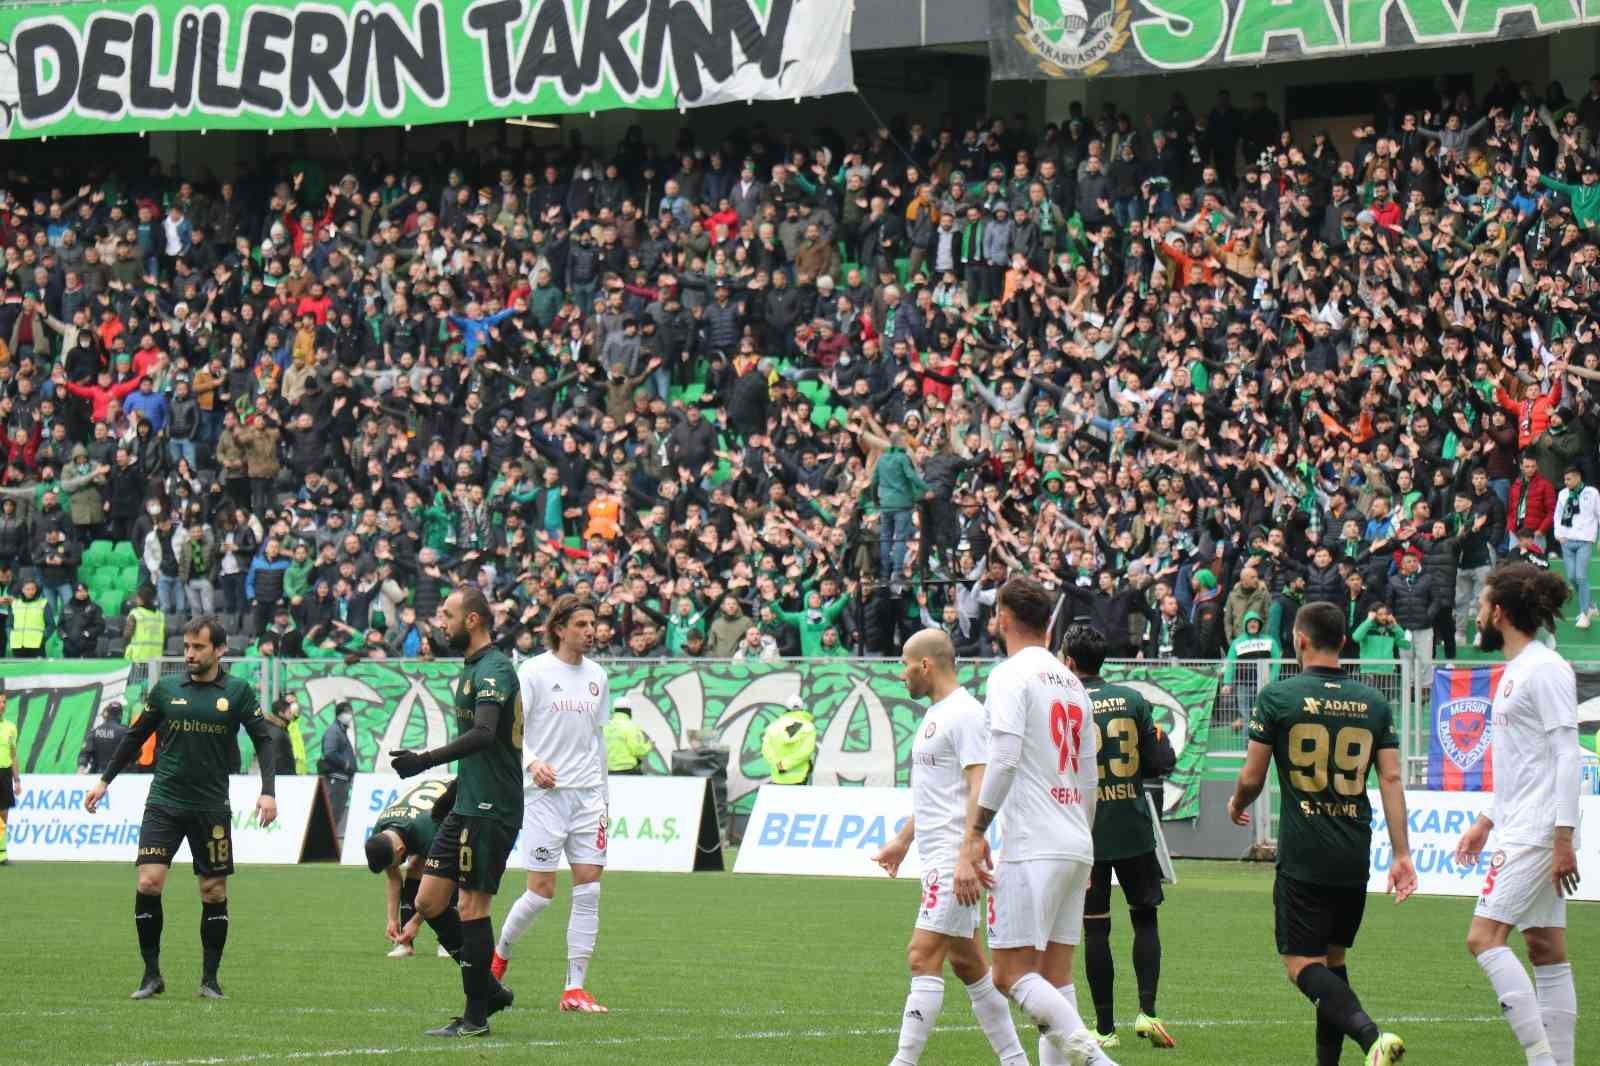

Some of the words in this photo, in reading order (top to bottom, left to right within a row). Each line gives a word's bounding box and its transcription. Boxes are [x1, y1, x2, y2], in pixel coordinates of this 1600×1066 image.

[1093, 697, 1126, 710] DATIP
[1324, 700, 1368, 712] ADATIP
[1288, 723, 1374, 796] 99
[15, 788, 112, 811] AKARA
[636, 818, 681, 844] A.Ş.
[207, 839, 230, 863] 18
